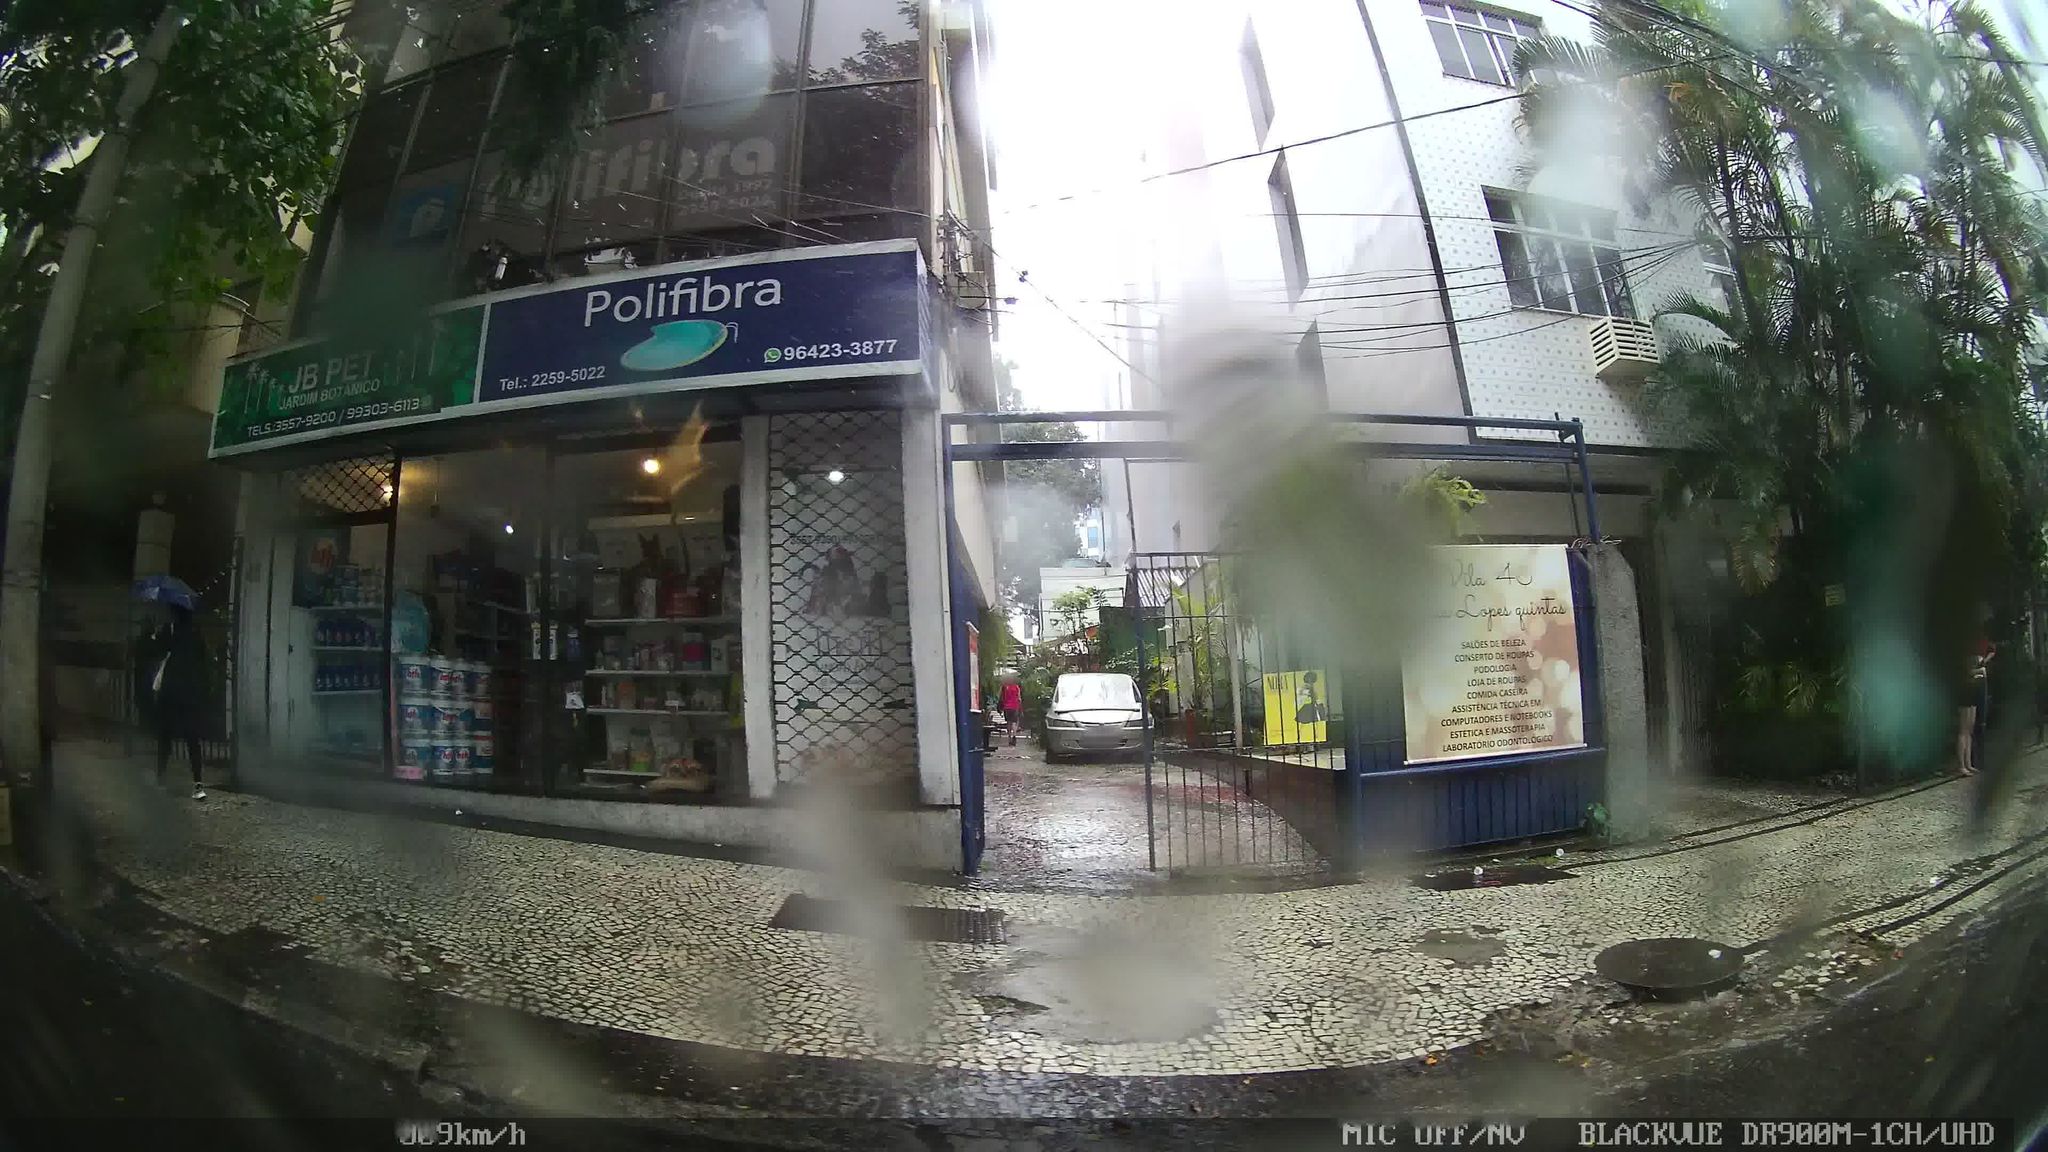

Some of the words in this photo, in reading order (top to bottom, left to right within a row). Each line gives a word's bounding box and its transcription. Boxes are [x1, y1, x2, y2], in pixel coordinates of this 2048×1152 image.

[584, 275, 782, 327] Polifibra
[784, 339, 898, 361] 96423-3877
[289, 364, 319, 393] JB
[499, 377, 528, 391] Tel.:
[531, 365, 606, 387] 2259-5022
[279, 391, 318, 410] JARDIM
[347, 398, 420, 419] 99303-6113
[1456, 594, 1511, 631] Lopes
[1490, 640, 1500, 648] DE
[1501, 638, 1526, 647] BELEZA
[1455, 652, 1494, 662] CONSERTO
[1495, 651, 1504, 660] DE
[1506, 650, 1535, 659] ROUPAS
[1473, 664, 1517, 674] PODOLOGIA
[1467, 678, 1485, 687] LOJA
[1487, 677, 1496, 686] DE
[1498, 675, 1527, 684] ROUPAS
[1467, 689, 1498, 699] COMIDA
[1499, 687, 1528, 697] CASEIRA
[1530, 698, 1541, 707] EM
[1441, 714, 1503, 727] COMPUTADORES
[1510, 710, 1552, 721] NOTEBOOKS
[1491, 723, 1546, 735] MASSOTERAPIA
